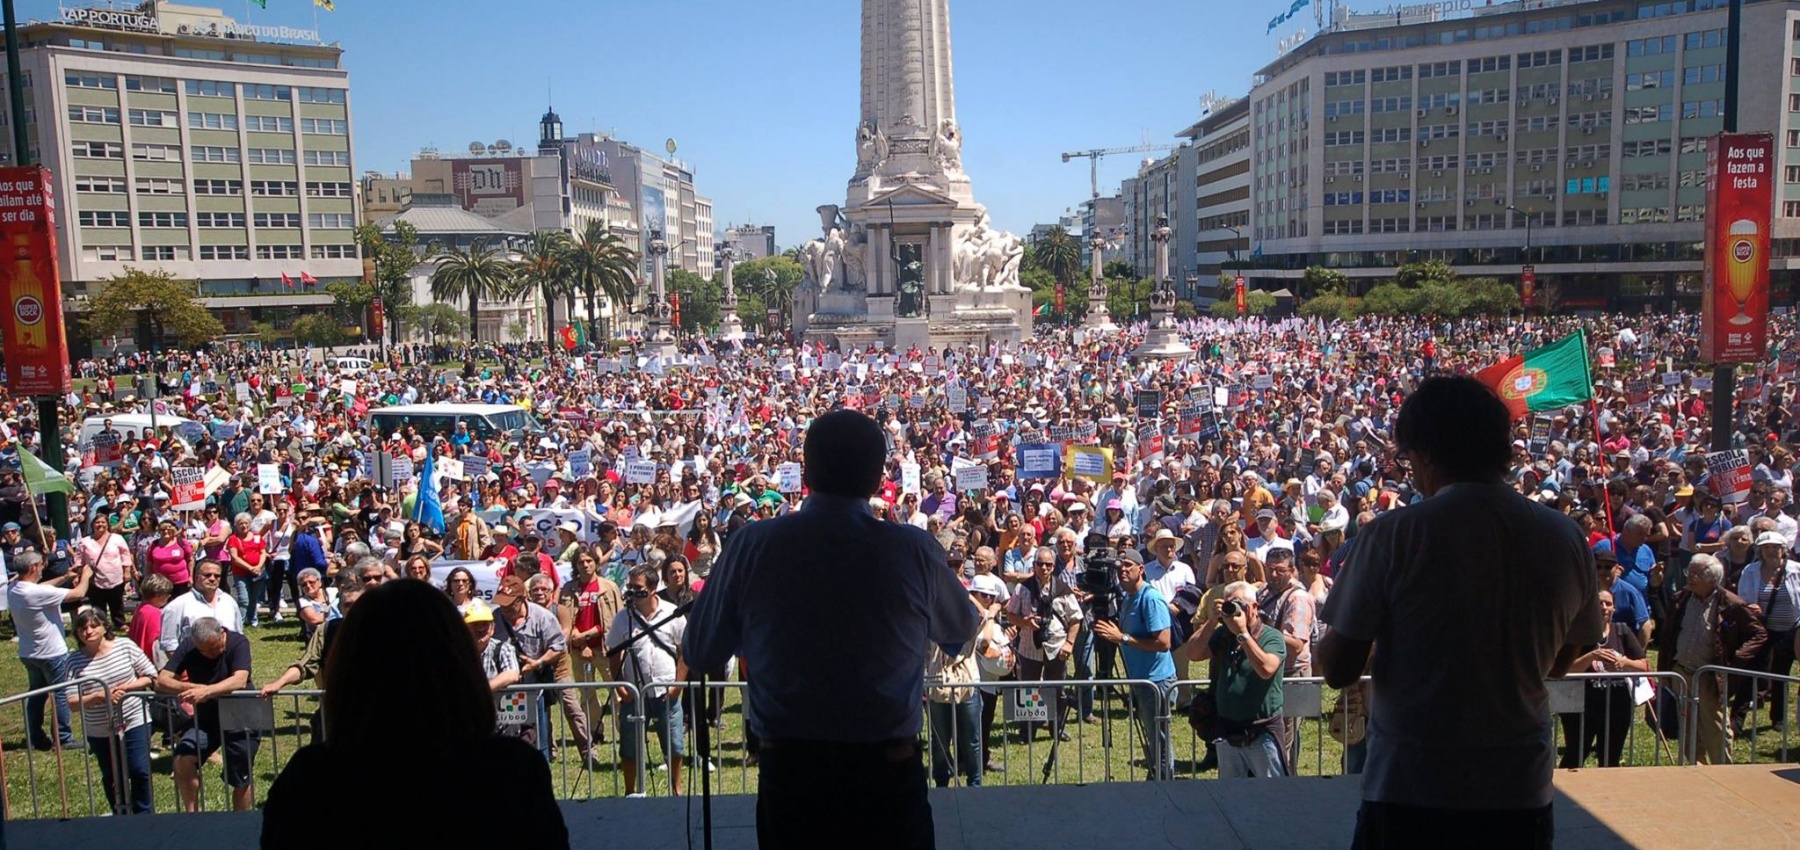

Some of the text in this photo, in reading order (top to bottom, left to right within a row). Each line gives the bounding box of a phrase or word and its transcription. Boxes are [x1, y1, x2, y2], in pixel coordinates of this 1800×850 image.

[60, 7, 160, 30] TAP PORTUGA
[1728, 146, 1765, 161] Aos que
[1727, 161, 1765, 173] fazem a
[16, 181, 34, 194] que
[1733, 176, 1758, 189] festa
[26, 193, 42, 206] até
[2, 209, 35, 222] ser dia
[1706, 449, 1744, 466] ESCOLA
[173, 467, 203, 478] ESCOLA
